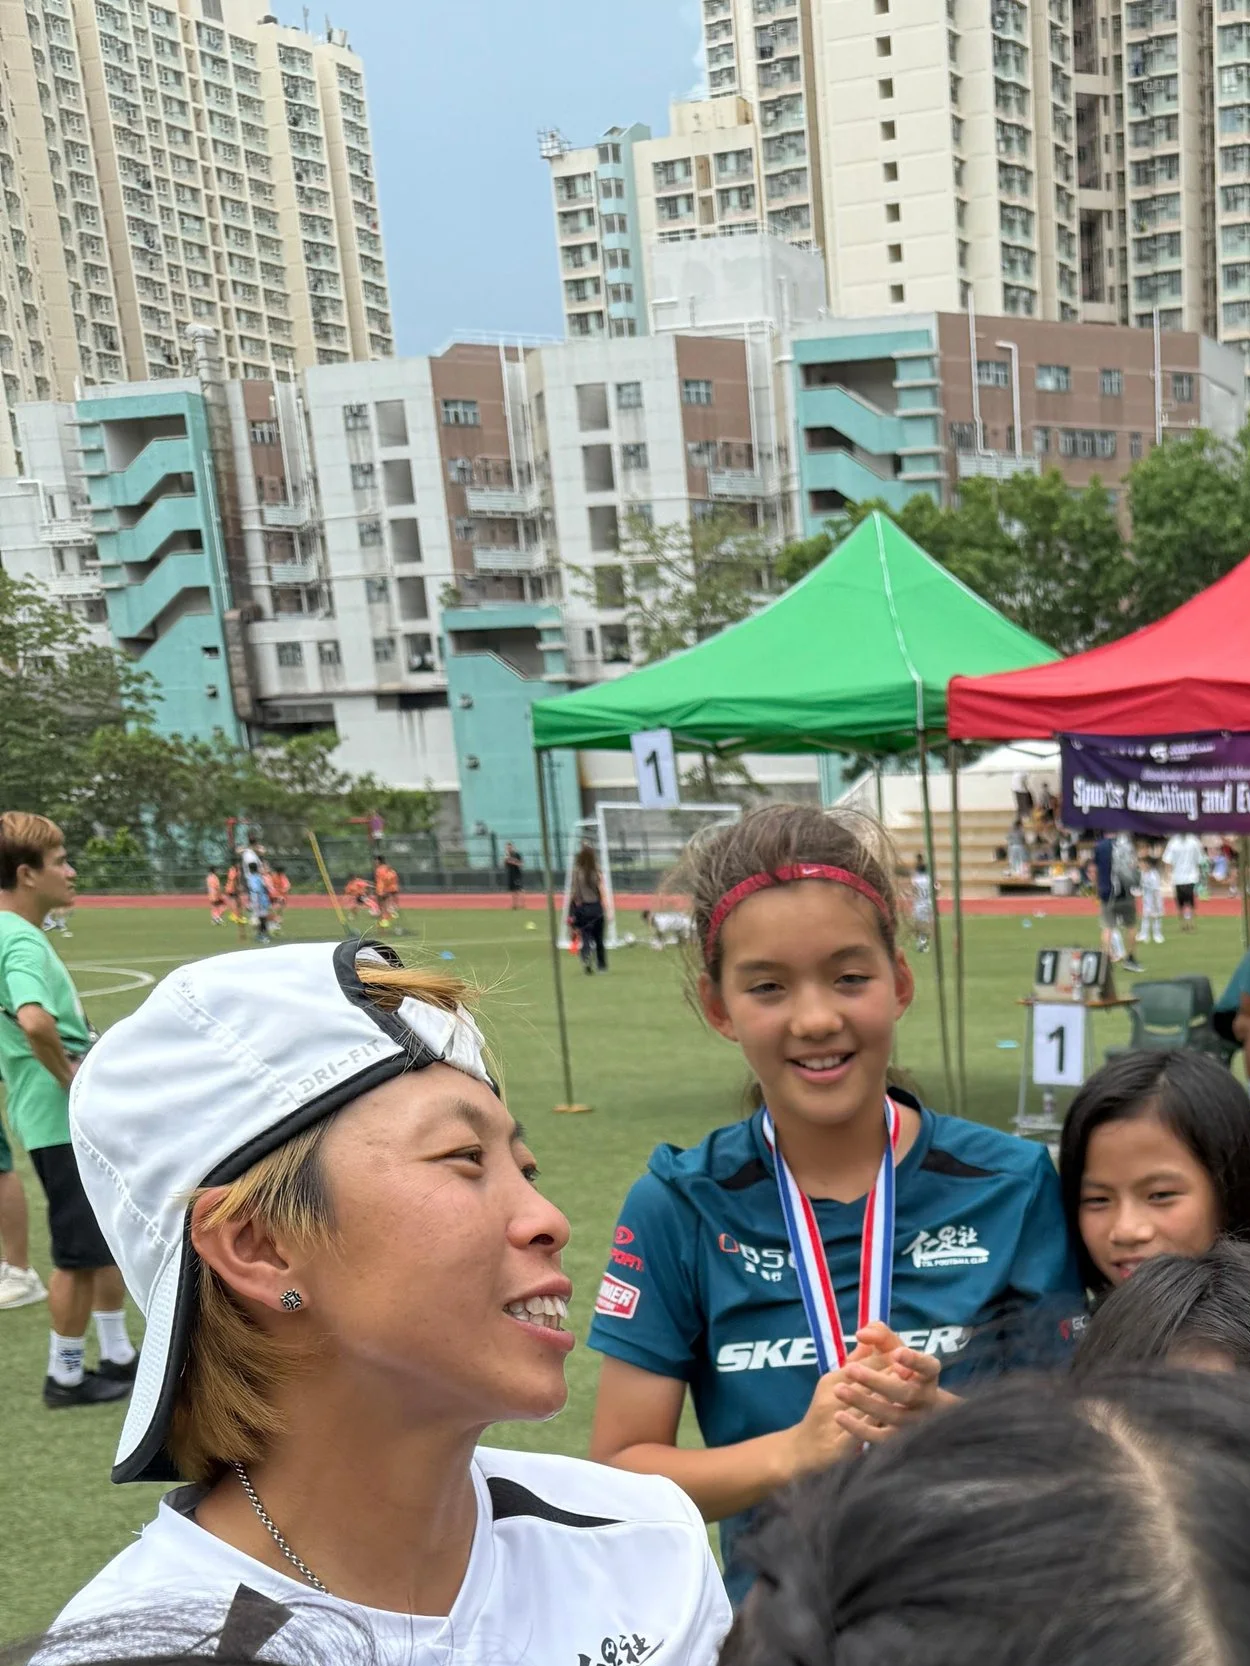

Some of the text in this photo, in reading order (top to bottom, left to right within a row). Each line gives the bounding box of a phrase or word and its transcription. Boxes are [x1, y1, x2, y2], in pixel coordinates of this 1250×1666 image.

[645, 749, 663, 797] 1
[1073, 774, 1124, 815] Sports
[1127, 780, 1198, 821] Coaching
[1201, 780, 1232, 814] and
[1041, 952, 1055, 984] 1
[299, 1039, 381, 1094] DRI-FIT
[1047, 1024, 1065, 1075] 1
